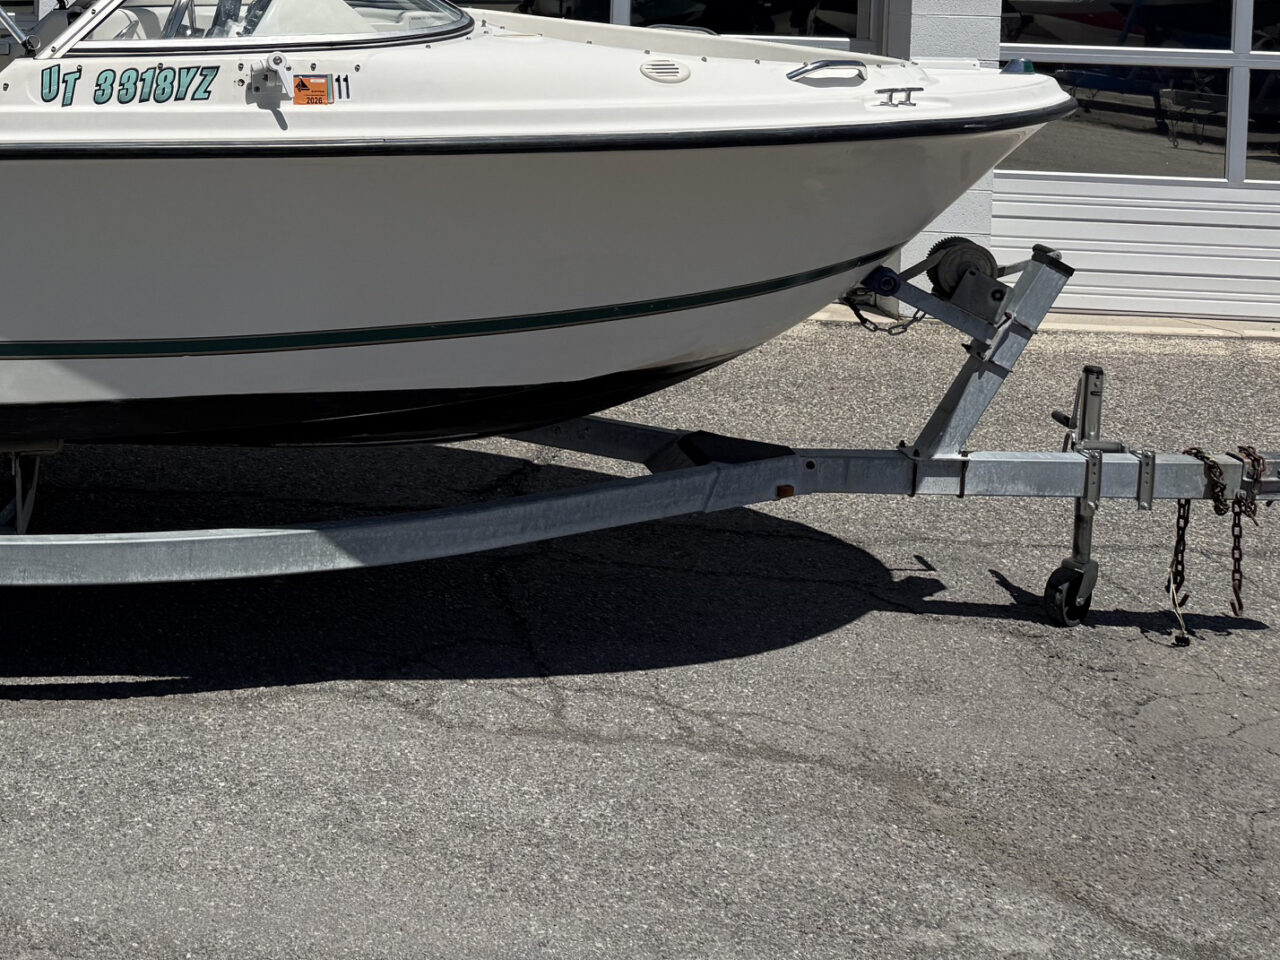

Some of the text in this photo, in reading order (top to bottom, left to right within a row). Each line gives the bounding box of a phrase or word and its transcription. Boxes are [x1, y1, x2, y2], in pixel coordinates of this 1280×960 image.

[41, 64, 220, 107] UT 3318YZ
[334, 74, 350, 100] 11
